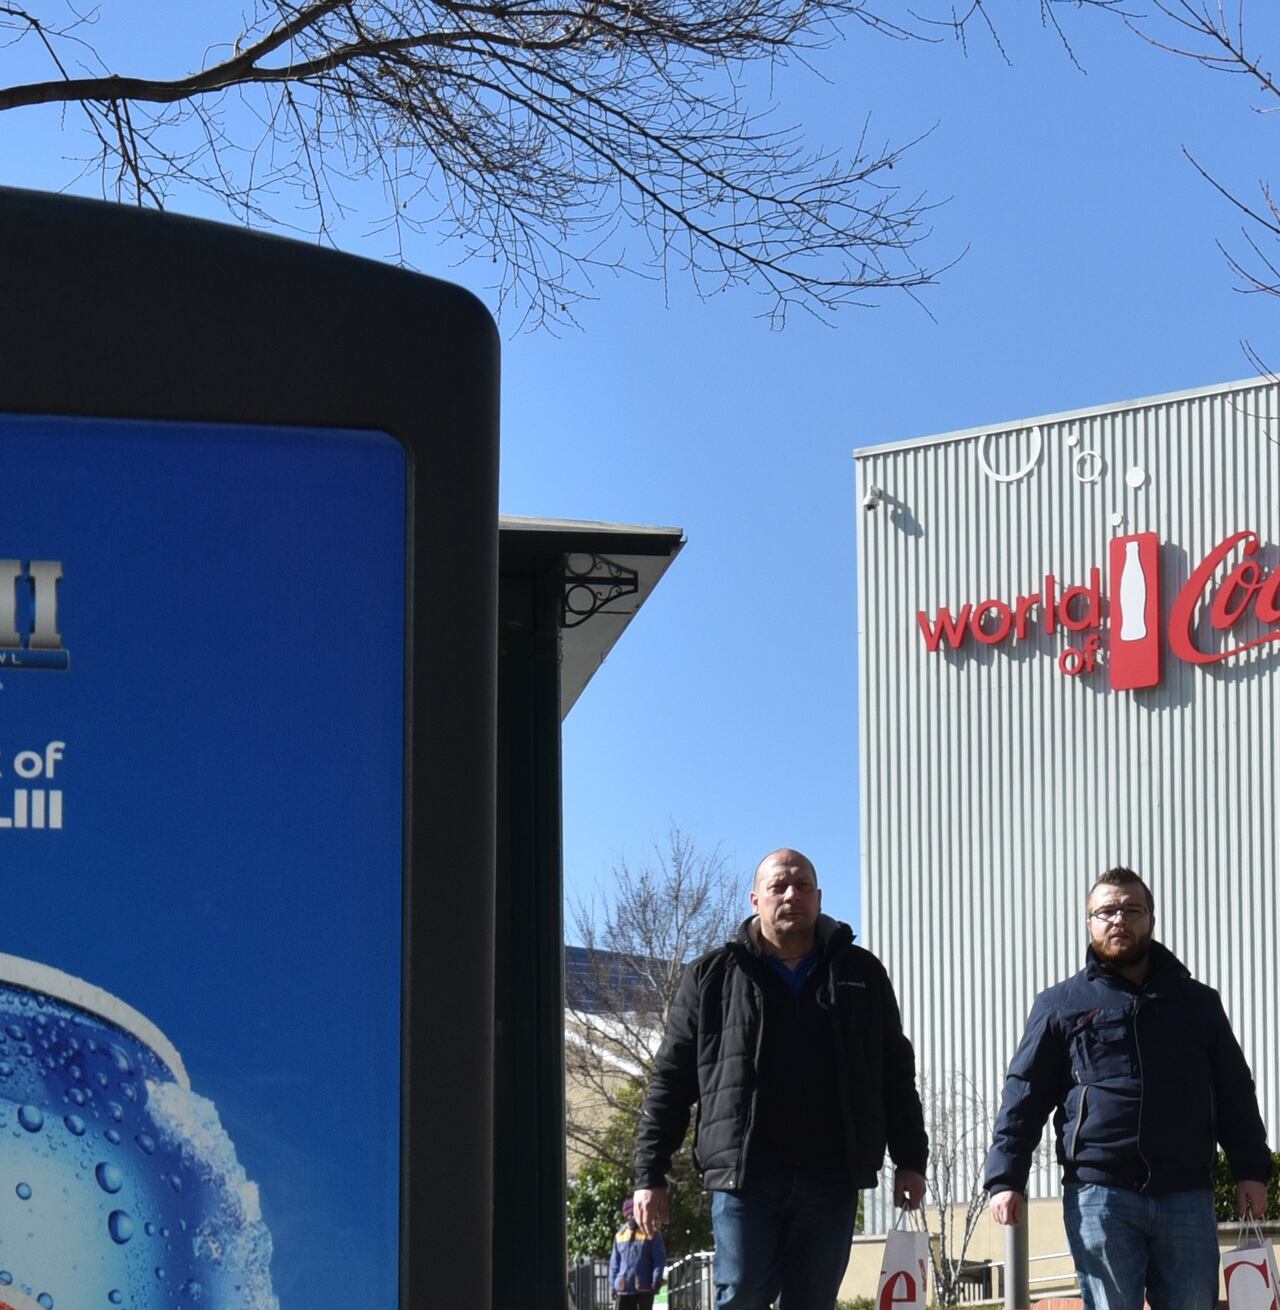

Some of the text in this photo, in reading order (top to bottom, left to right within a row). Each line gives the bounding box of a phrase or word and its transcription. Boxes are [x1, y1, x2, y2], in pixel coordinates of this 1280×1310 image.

[916, 567, 1100, 652] world
[1059, 635, 1101, 676] of
[13, 741, 66, 779] of
